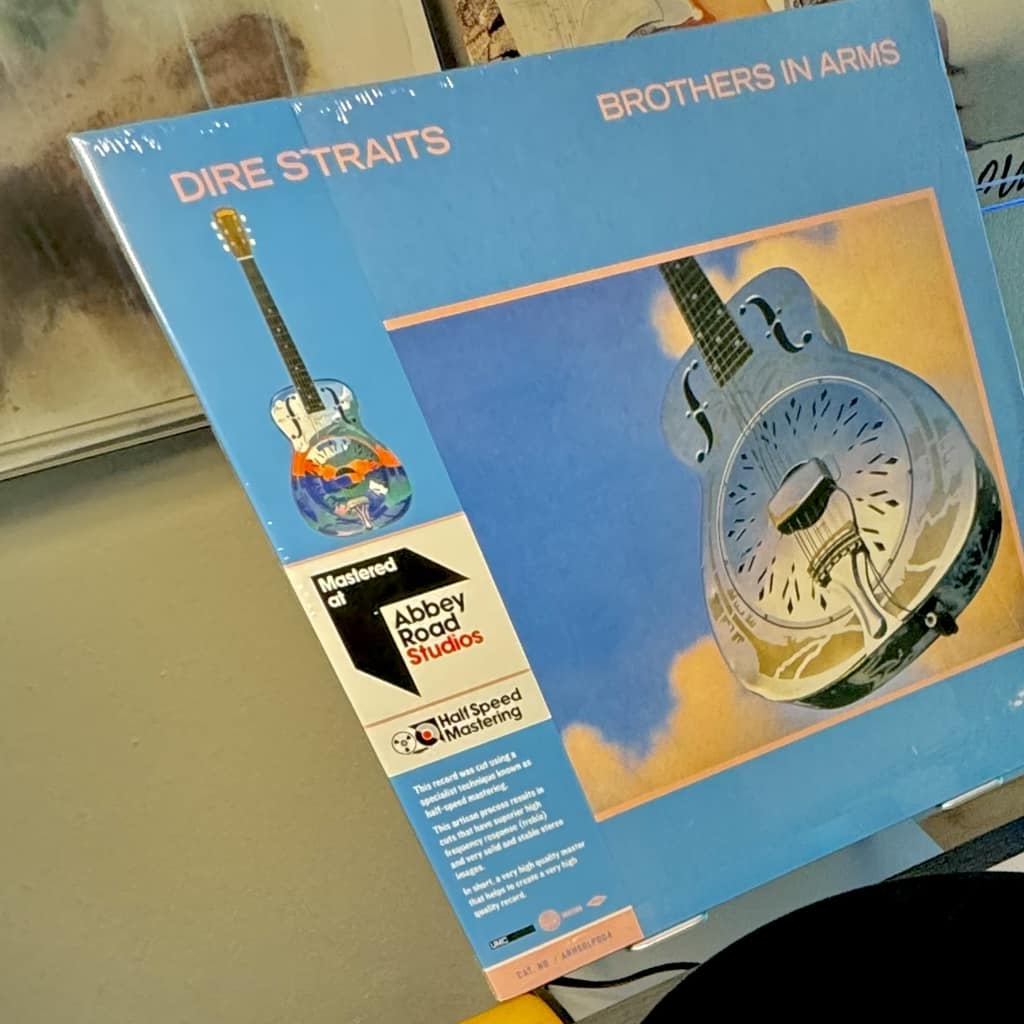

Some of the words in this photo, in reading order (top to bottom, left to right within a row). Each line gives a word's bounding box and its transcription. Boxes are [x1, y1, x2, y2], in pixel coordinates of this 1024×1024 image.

[596, 63, 776, 121] BROTHERS
[780, 56, 813, 85] IN
[819, 38, 900, 78] ARMS
[169, 157, 274, 203] DIRE
[276, 125, 451, 181] STRAITS
[317, 556, 398, 593] Mastered
[327, 591, 347, 608] at
[395, 592, 465, 629] Abbey
[397, 613, 461, 648] Road
[406, 630, 484, 666] Studios
[437, 706, 470, 728] Half
[470, 687, 523, 716] Speed
[444, 706, 523, 742] Mastering
[413, 784, 432, 794] This
[432, 772, 458, 787] record
[459, 767, 475, 777] was
[475, 761, 488, 772] cut
[489, 753, 511, 767] using
[420, 787, 457, 806] specialist
[457, 773, 496, 792] technique
[496, 764, 521, 777] known
[522, 760, 531, 768] as
[425, 796, 467, 818] half-speed
[432, 824, 451, 834] This
[479, 801, 509, 818] process
[440, 835, 457, 846] cuts
[457, 828, 474, 838] that
[473, 821, 493, 832] have
[493, 808, 523, 825] superior
[524, 801, 541, 812] high
[445, 838, 483, 857] frequency
[484, 825, 518, 842] response
[451, 857, 465, 869] and
[465, 852, 482, 862] very
[484, 842, 502, 855] solid
[502, 837, 517, 848] and
[517, 828, 540, 842] stable
[540, 820, 563, 832] stereo
[469, 895, 485, 906] that
[485, 887, 506, 899] helps
[516, 874, 539, 887] create
[545, 864, 560, 874] very
[561, 857, 577, 868] high
[501, 870, 517, 880] very
[518, 862, 535, 873] high
[535, 852, 559, 867] quality
[474, 903, 500, 918] quality
